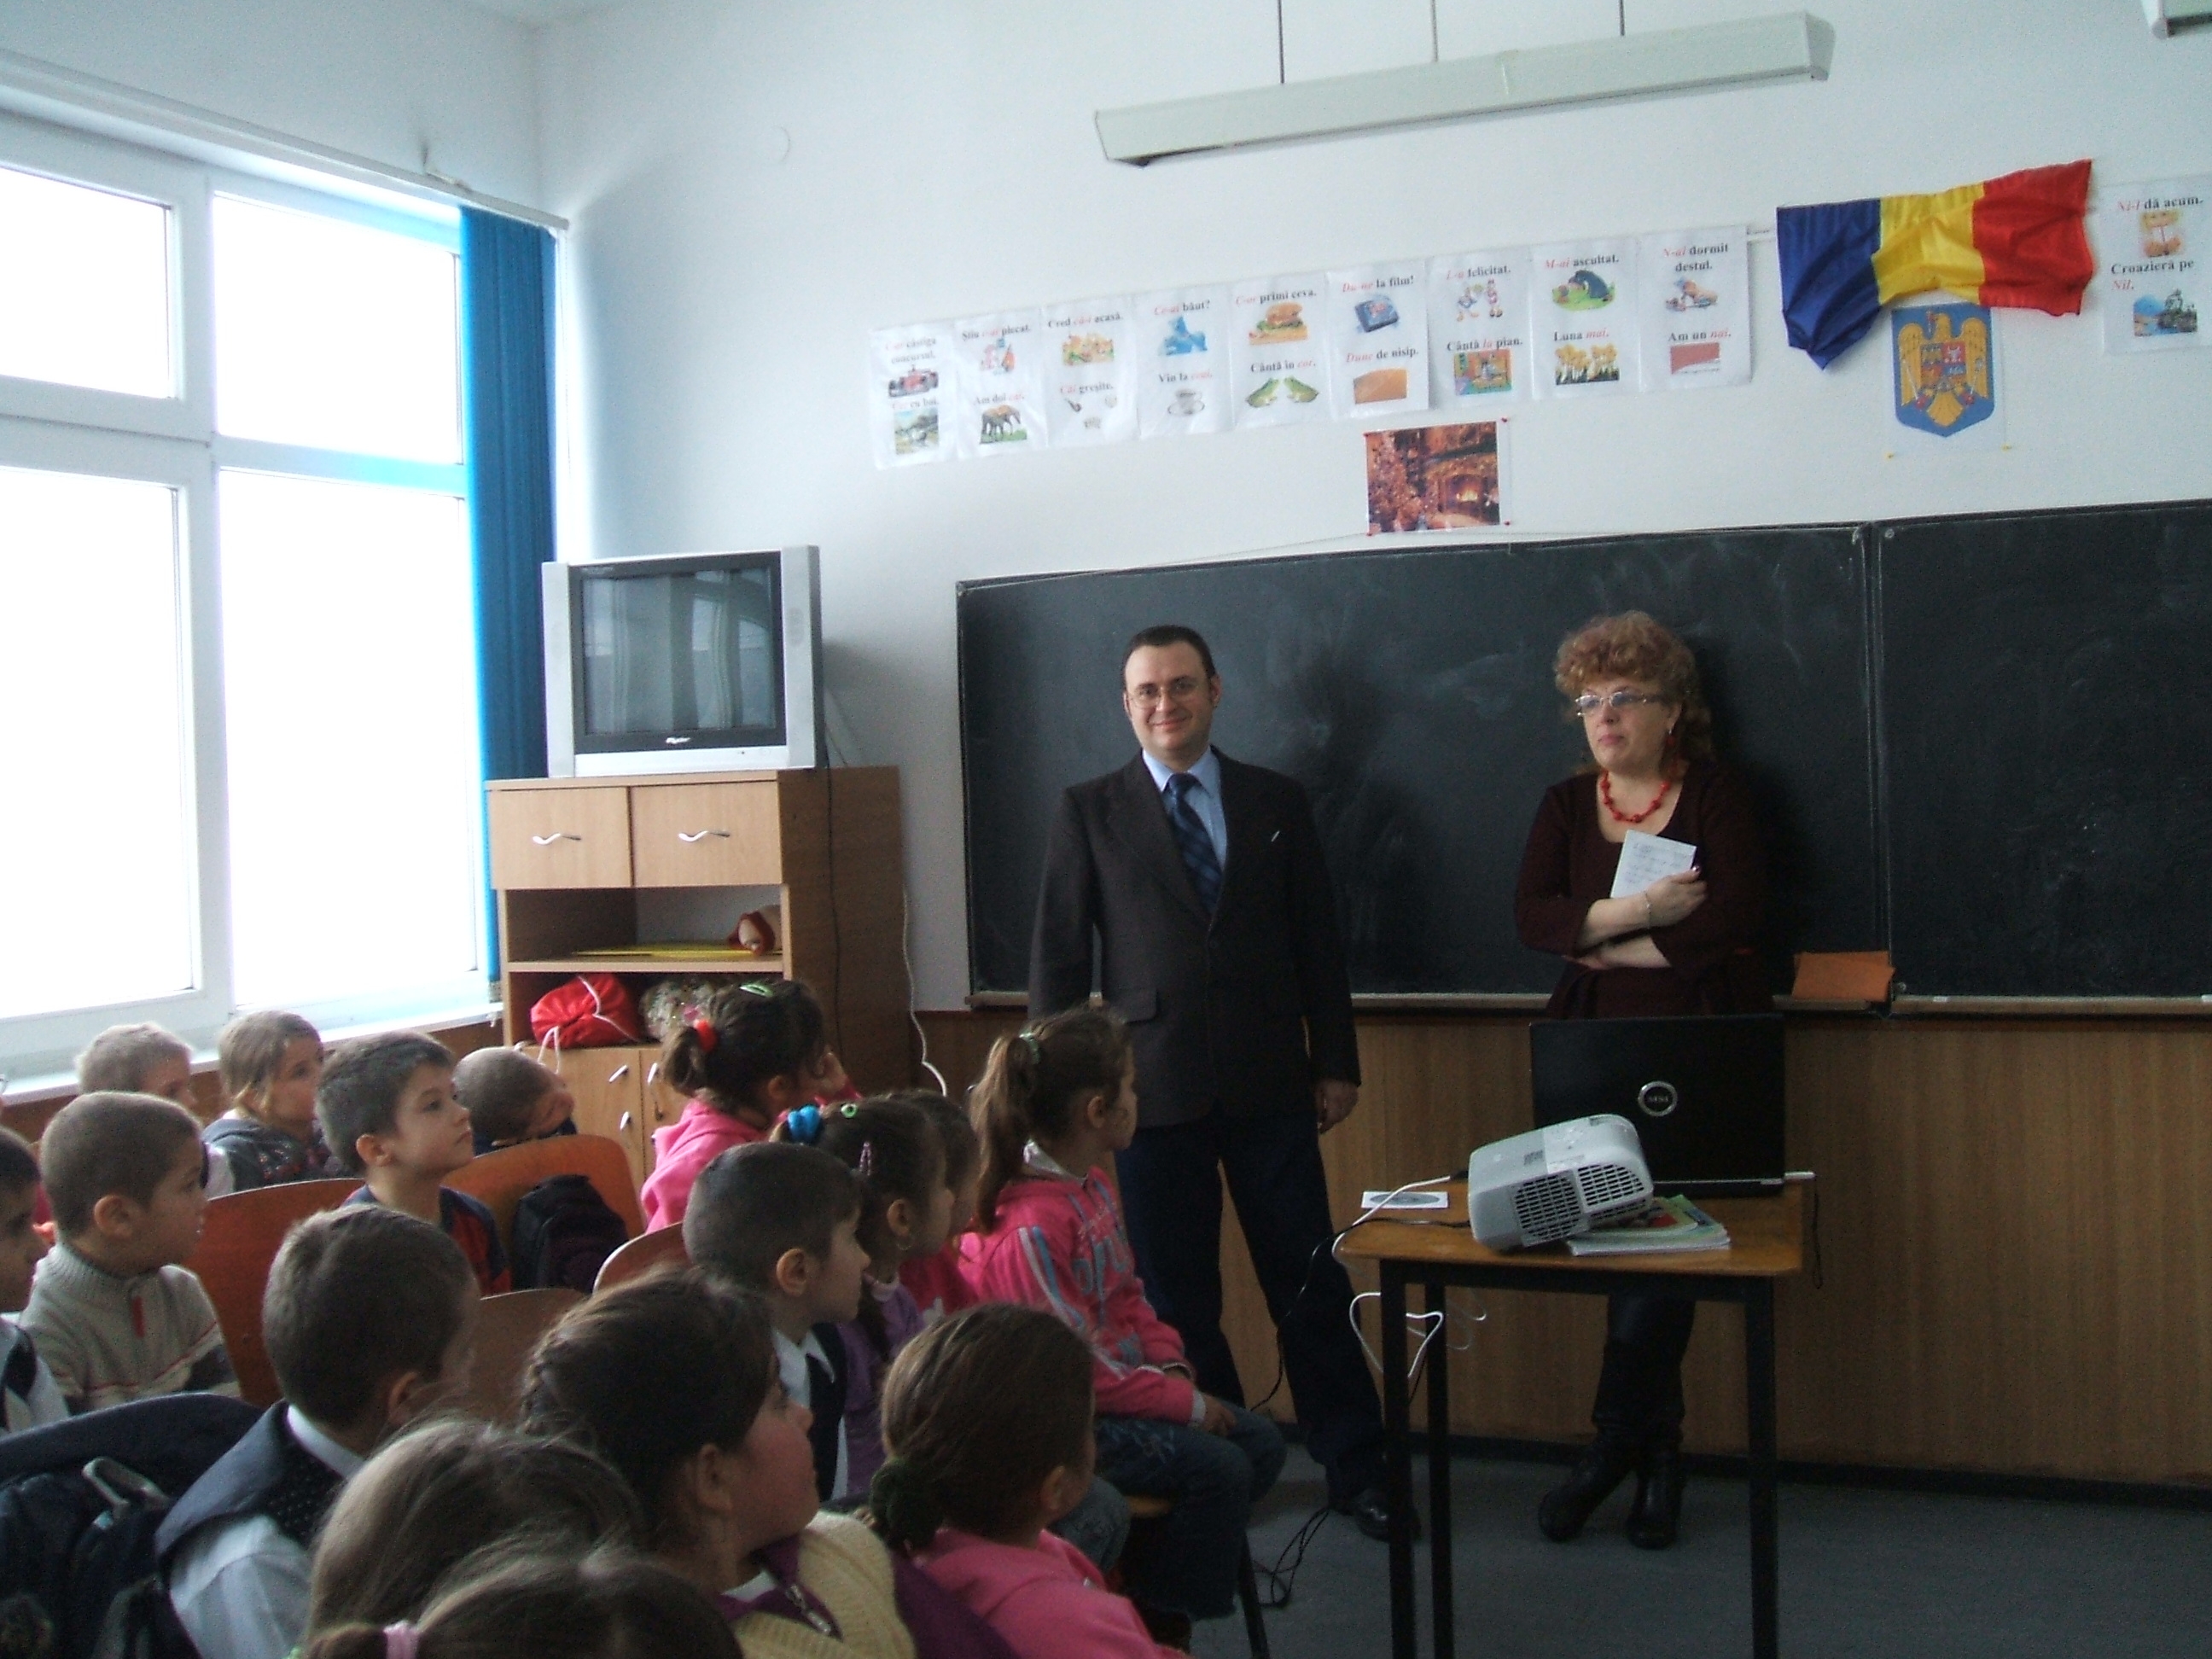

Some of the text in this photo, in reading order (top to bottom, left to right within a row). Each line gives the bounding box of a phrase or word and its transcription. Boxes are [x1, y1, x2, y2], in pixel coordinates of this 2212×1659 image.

[2144, 198, 2159, 209] dă
[2164, 196, 2203, 207] acum.
[1689, 242, 1728, 255] dormit
[1573, 254, 1619, 266] ascultat.
[1675, 259, 1713, 272] destul.
[2110, 259, 2194, 274] Croazieră pe
[1468, 265, 1511, 277] felicitat.
[1377, 278, 1386, 288] la
[1389, 275, 1414, 287] film!
[2113, 279, 2134, 290] Nil.
[1260, 291, 1289, 304] primi
[1291, 289, 1317, 299] ceva.
[1048, 316, 1071, 328] Cred
[1554, 328, 1609, 341] Luna mai.
[1668, 332, 1689, 341] Am
[1482, 339, 1493, 348] la
[1496, 337, 1522, 350] pian.
[1346, 346, 1418, 362] Dune de nisip.
[1158, 373, 1176, 382] Vin
